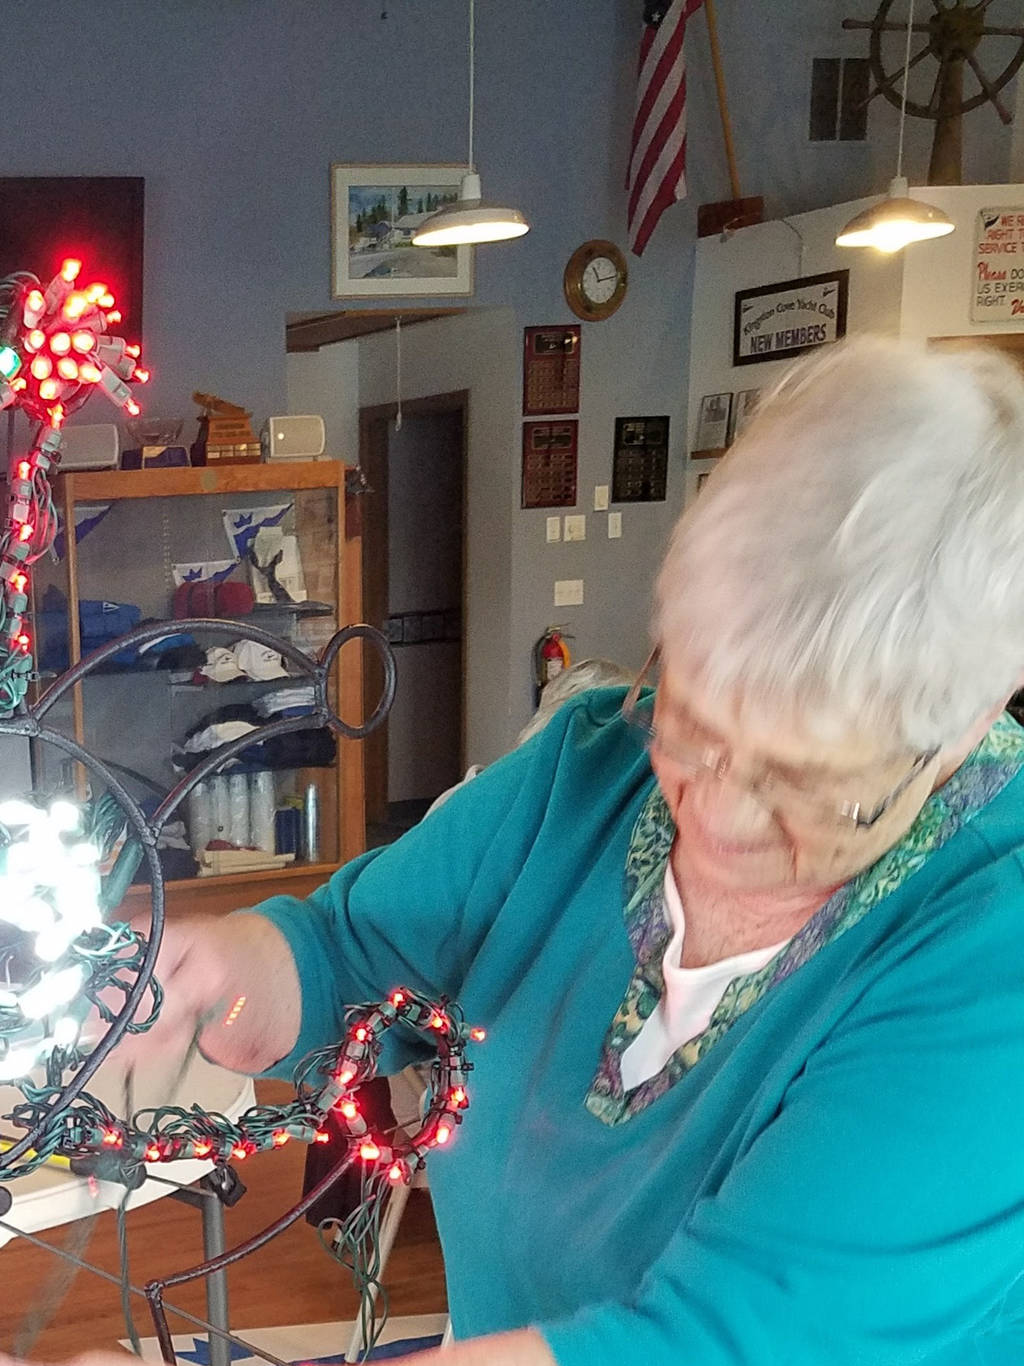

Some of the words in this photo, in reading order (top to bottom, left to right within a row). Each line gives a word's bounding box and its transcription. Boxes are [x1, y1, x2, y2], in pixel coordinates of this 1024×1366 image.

[1001, 215, 1015, 226] WE
[978, 242, 1017, 254] SERVICE
[977, 283, 991, 294] US
[776, 302, 795, 313] Cove
[796, 298, 818, 313] Yacht
[818, 303, 836, 319] Club
[750, 333, 774, 354] NEW
[775, 323, 827, 349] MEMBERS
